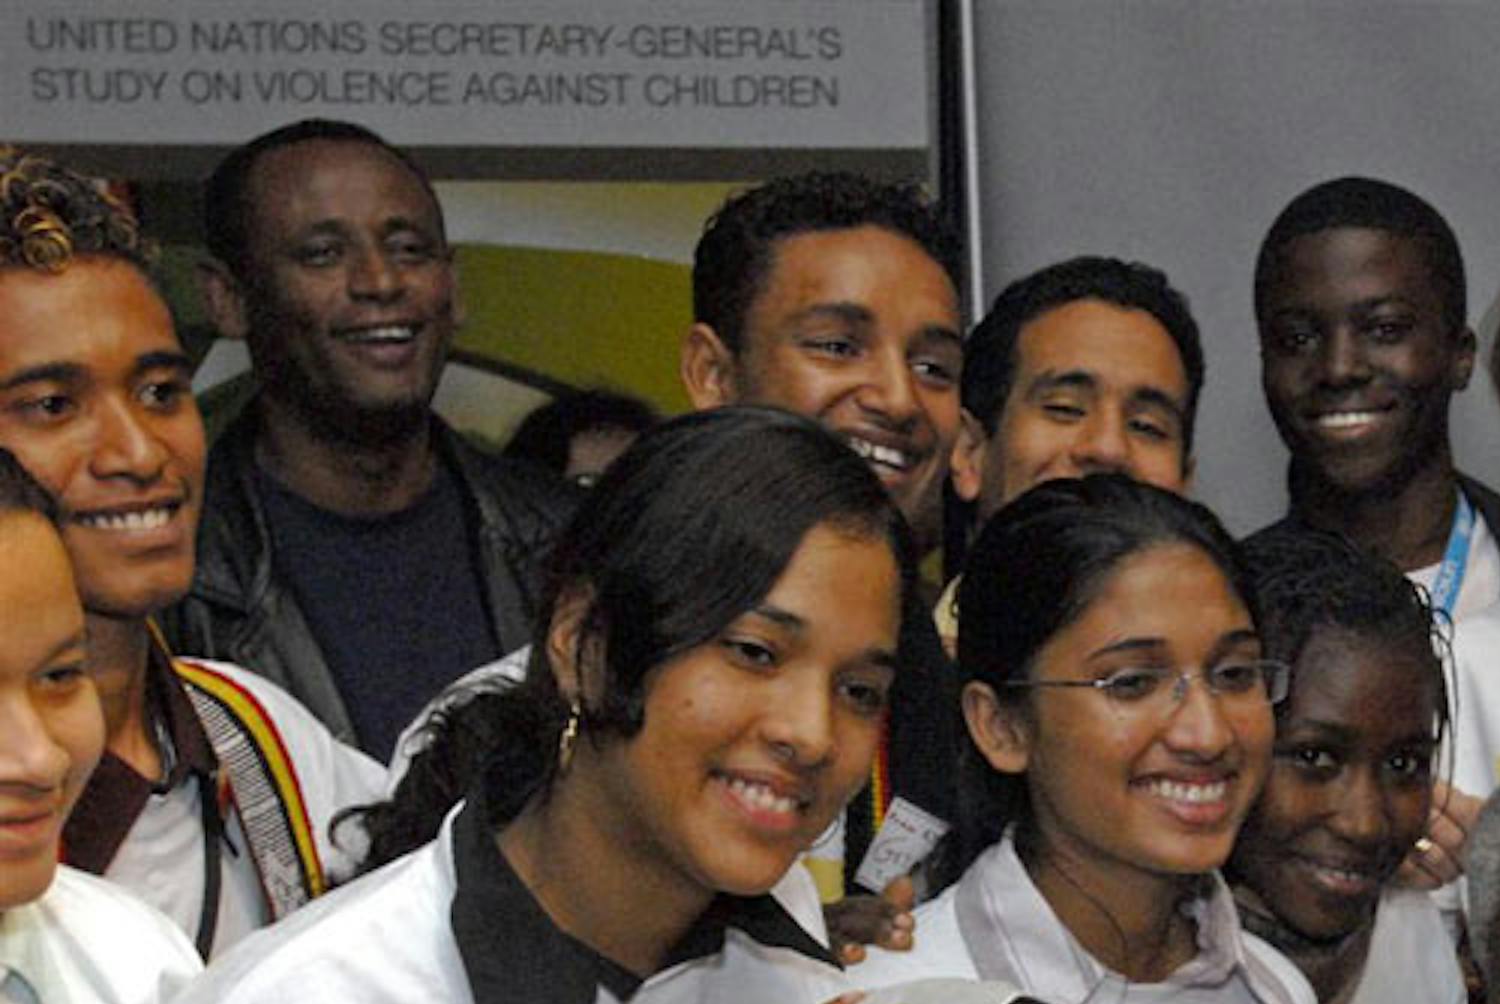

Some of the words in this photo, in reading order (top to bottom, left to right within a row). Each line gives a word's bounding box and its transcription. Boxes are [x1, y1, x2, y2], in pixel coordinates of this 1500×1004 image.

[27, 17, 178, 53] UNITED
[191, 20, 367, 55] NATIONS
[379, 21, 842, 60] SECRETARY-GENERAL'S
[30, 67, 168, 102] STUDY
[180, 69, 242, 103] ON
[252, 70, 452, 105] VIOLENCE
[463, 71, 633, 107] AGAINST
[643, 73, 839, 108] CHILDREN
